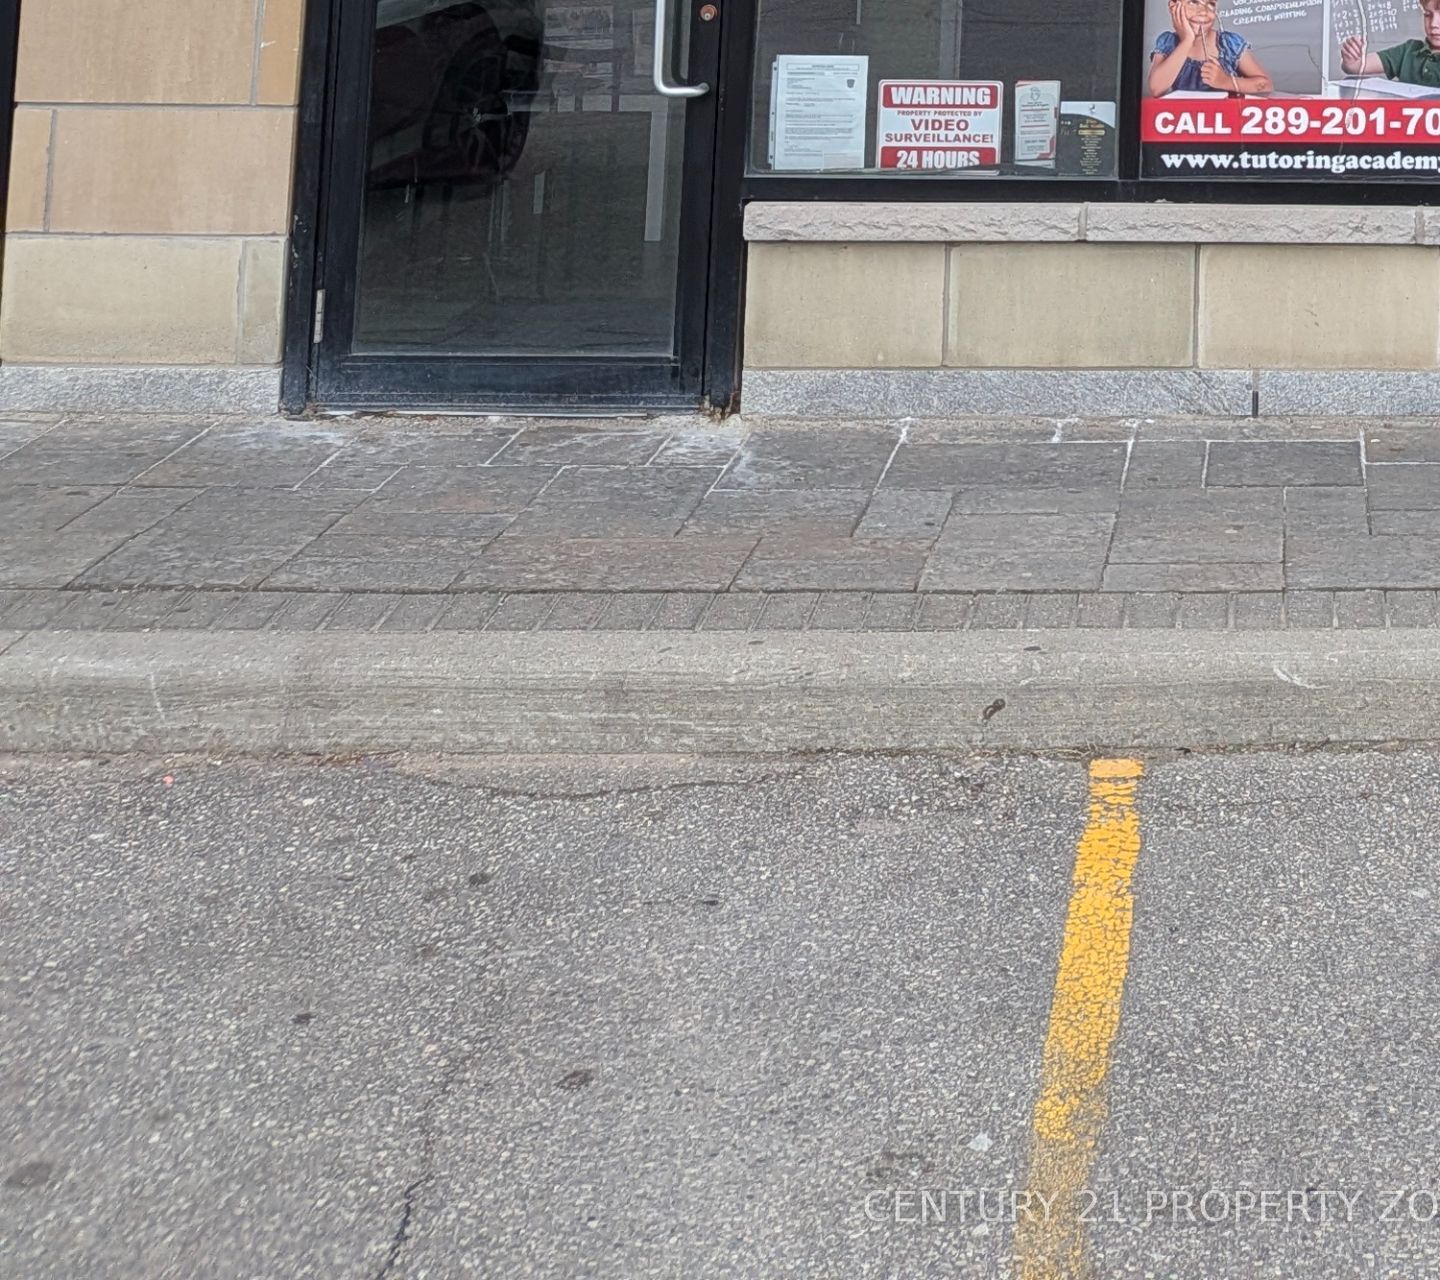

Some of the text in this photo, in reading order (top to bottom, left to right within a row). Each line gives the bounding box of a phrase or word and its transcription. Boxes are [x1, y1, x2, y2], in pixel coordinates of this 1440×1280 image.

[890, 86, 992, 105] WARNING
[896, 109, 931, 117] PROPERTY
[934, 109, 971, 117] PROTECTED
[910, 118, 970, 132] VIDEO
[1154, 111, 1231, 135] CALL
[884, 132, 994, 144] SURVEILLANCE!
[896, 150, 981, 168] 24 HOURS
